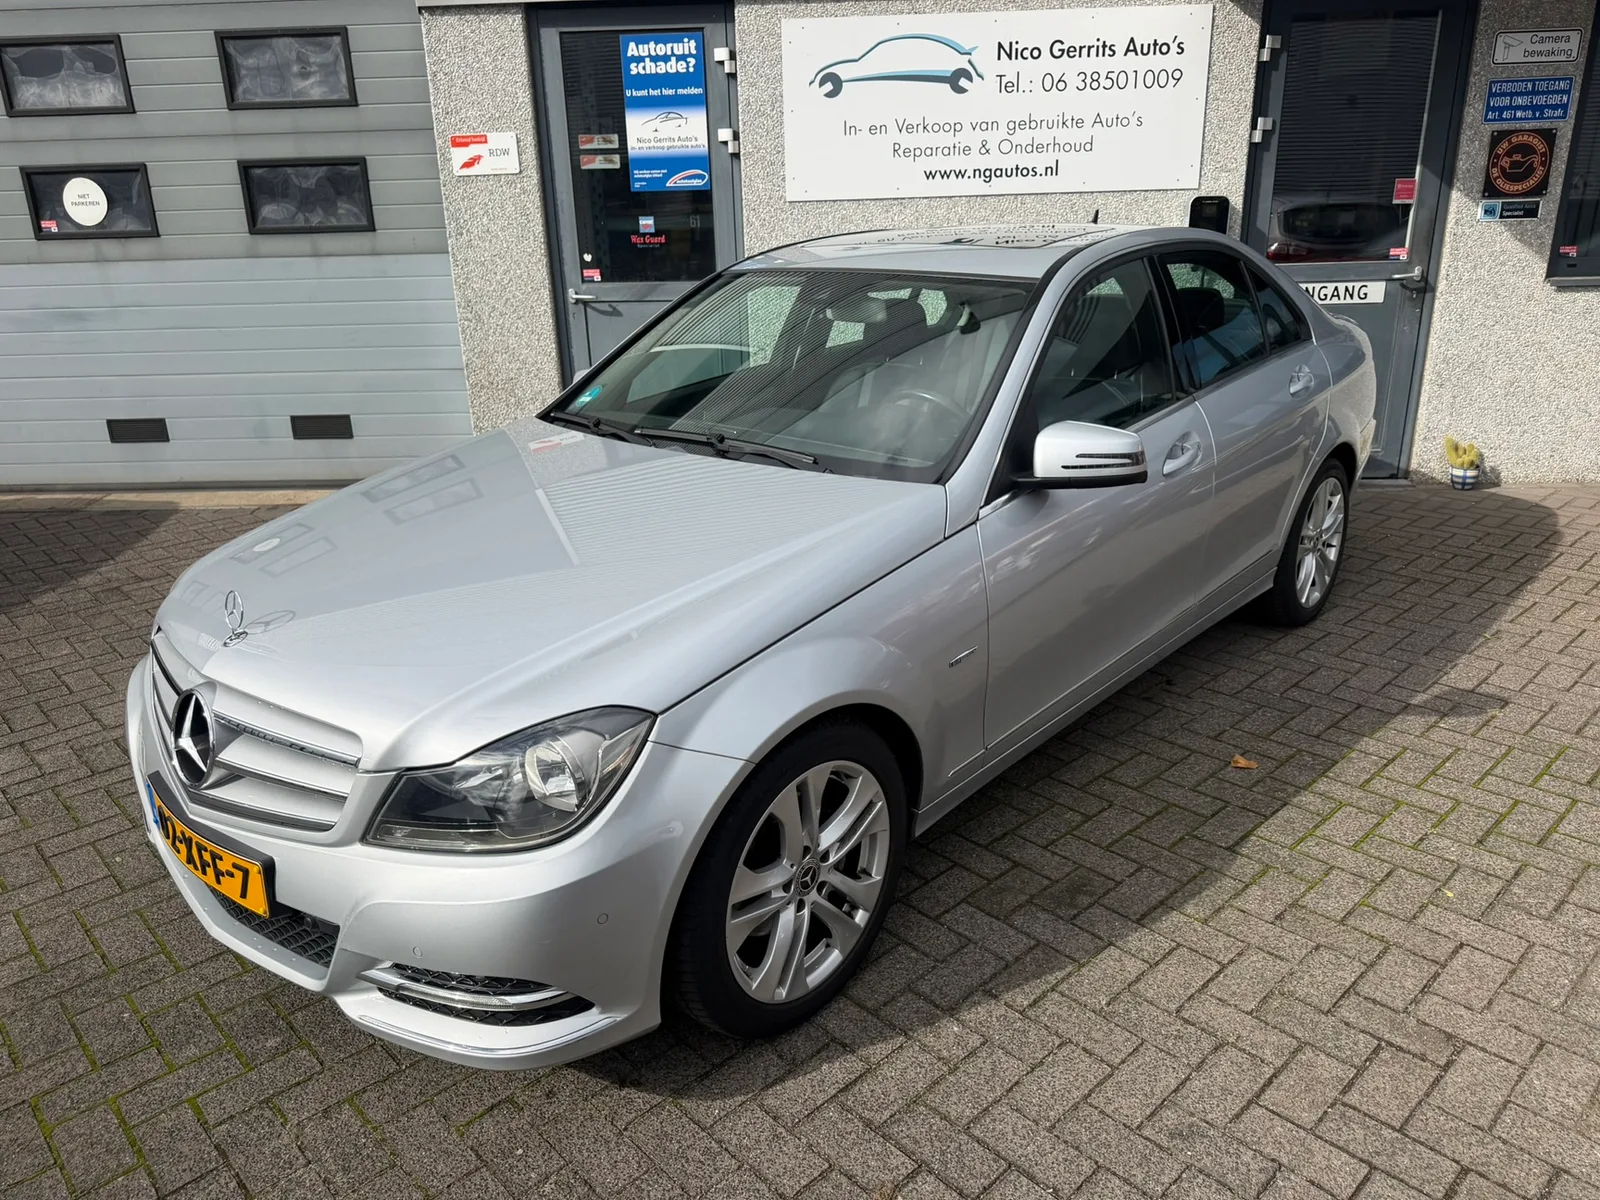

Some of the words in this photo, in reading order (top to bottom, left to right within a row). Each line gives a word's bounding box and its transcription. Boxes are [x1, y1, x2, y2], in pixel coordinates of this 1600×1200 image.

[1530, 34, 1570, 44] Camera
[627, 37, 697, 57] Autoruit
[997, 40, 1042, 61] Nico
[1049, 37, 1116, 60] Gerrits
[1123, 35, 1185, 57] Auto's
[1523, 47, 1573, 59] bewaking
[629, 57, 696, 75] schade?
[996, 71, 1033, 93] Tel.:
[1041, 72, 1067, 92] 06
[1076, 68, 1183, 92] 38501009
[1492, 81, 1533, 93] VERBODEN
[1534, 80, 1570, 92] TOEGANG
[625, 89, 631, 97] U
[632, 88, 649, 97] kunt
[649, 88, 661, 96] het
[662, 87, 676, 95] hier
[677, 86, 703, 95] melden
[1490, 96, 1511, 107] VOOR
[1512, 94, 1568, 106] ONBEVOEGDEN
[1487, 111, 1500, 120] Art.
[1502, 110, 1514, 119] 461
[1515, 110, 1534, 119] Wetb.
[1543, 108, 1565, 118] Strafr.
[843, 120, 862, 136] In-
[868, 123, 888, 136] en
[894, 116, 963, 137] Verkoop
[970, 120, 999, 132] van
[1006, 112, 1085, 136] gebruikte
[1091, 111, 1144, 129] Auto's
[653, 136, 676, 144] Gerrits
[677, 135, 698, 143] Auto's
[1496, 141, 1509, 155] UW
[1511, 134, 1546, 153] GARAGIST
[488, 148, 510, 157] RDW
[893, 141, 972, 162] Reparatie
[978, 139, 991, 156] &
[998, 135, 1094, 155] Onderhoud
[923, 159, 1060, 183] www.ngautos.nl
[1492, 167, 1500, 178] DE
[1496, 166, 1545, 191] OLIESPECIALIST
[689, 215, 700, 228] 61
[645, 234, 666, 244] Guard
[1305, 285, 1368, 301] NGANG
